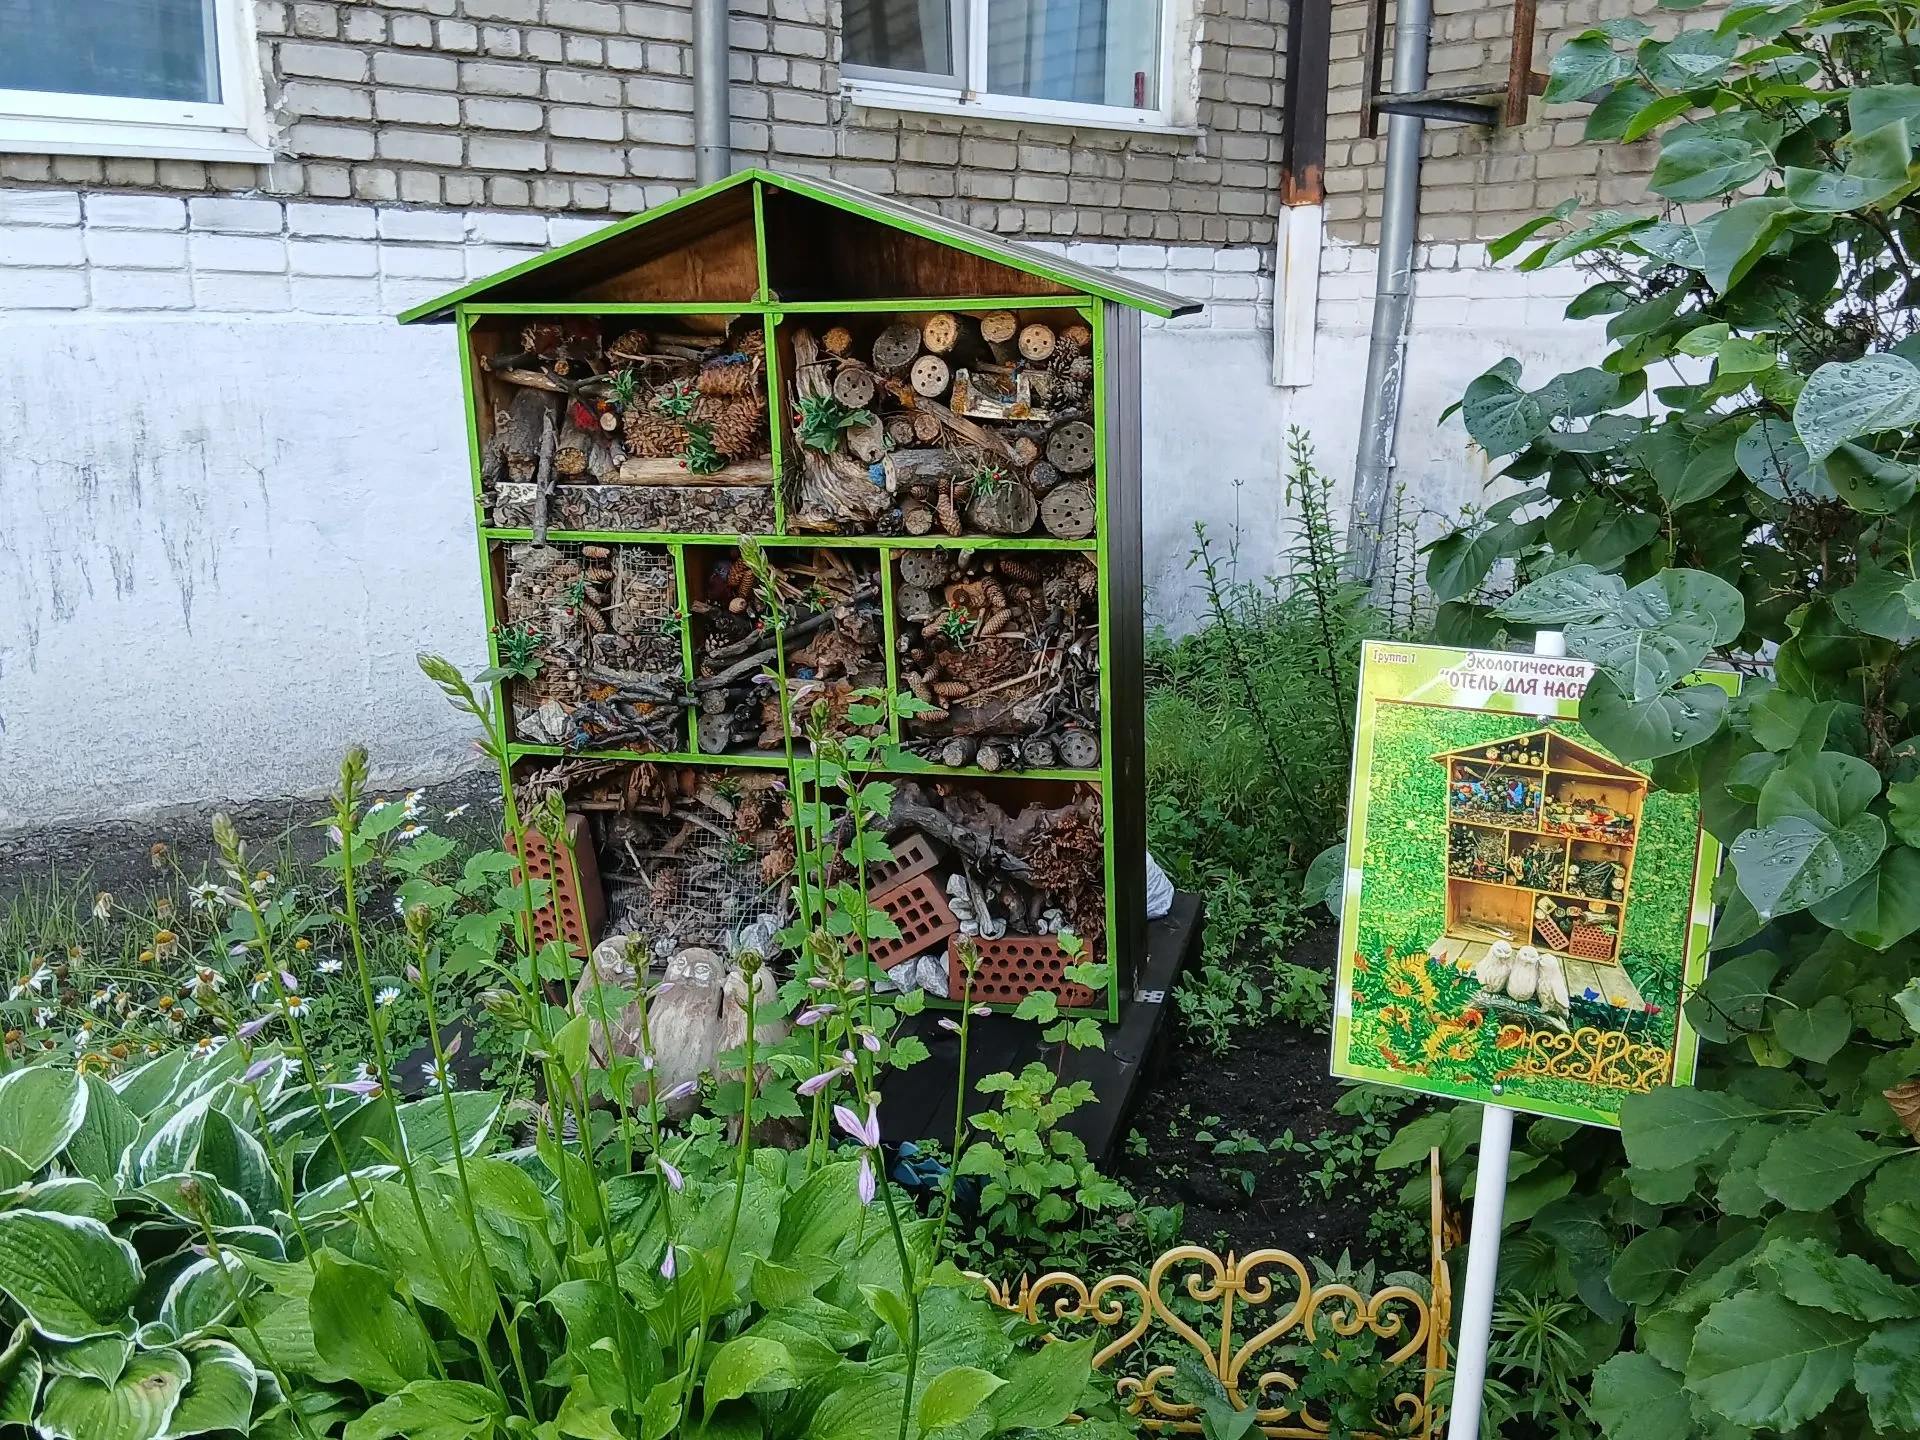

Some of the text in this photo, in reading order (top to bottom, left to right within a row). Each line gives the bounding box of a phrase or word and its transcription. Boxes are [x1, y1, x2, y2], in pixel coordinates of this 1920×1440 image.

[1373, 650, 1416, 664] Группа 1
[1466, 652, 1585, 679] Экологическая
[1503, 677, 1539, 696] ДЛЯ
